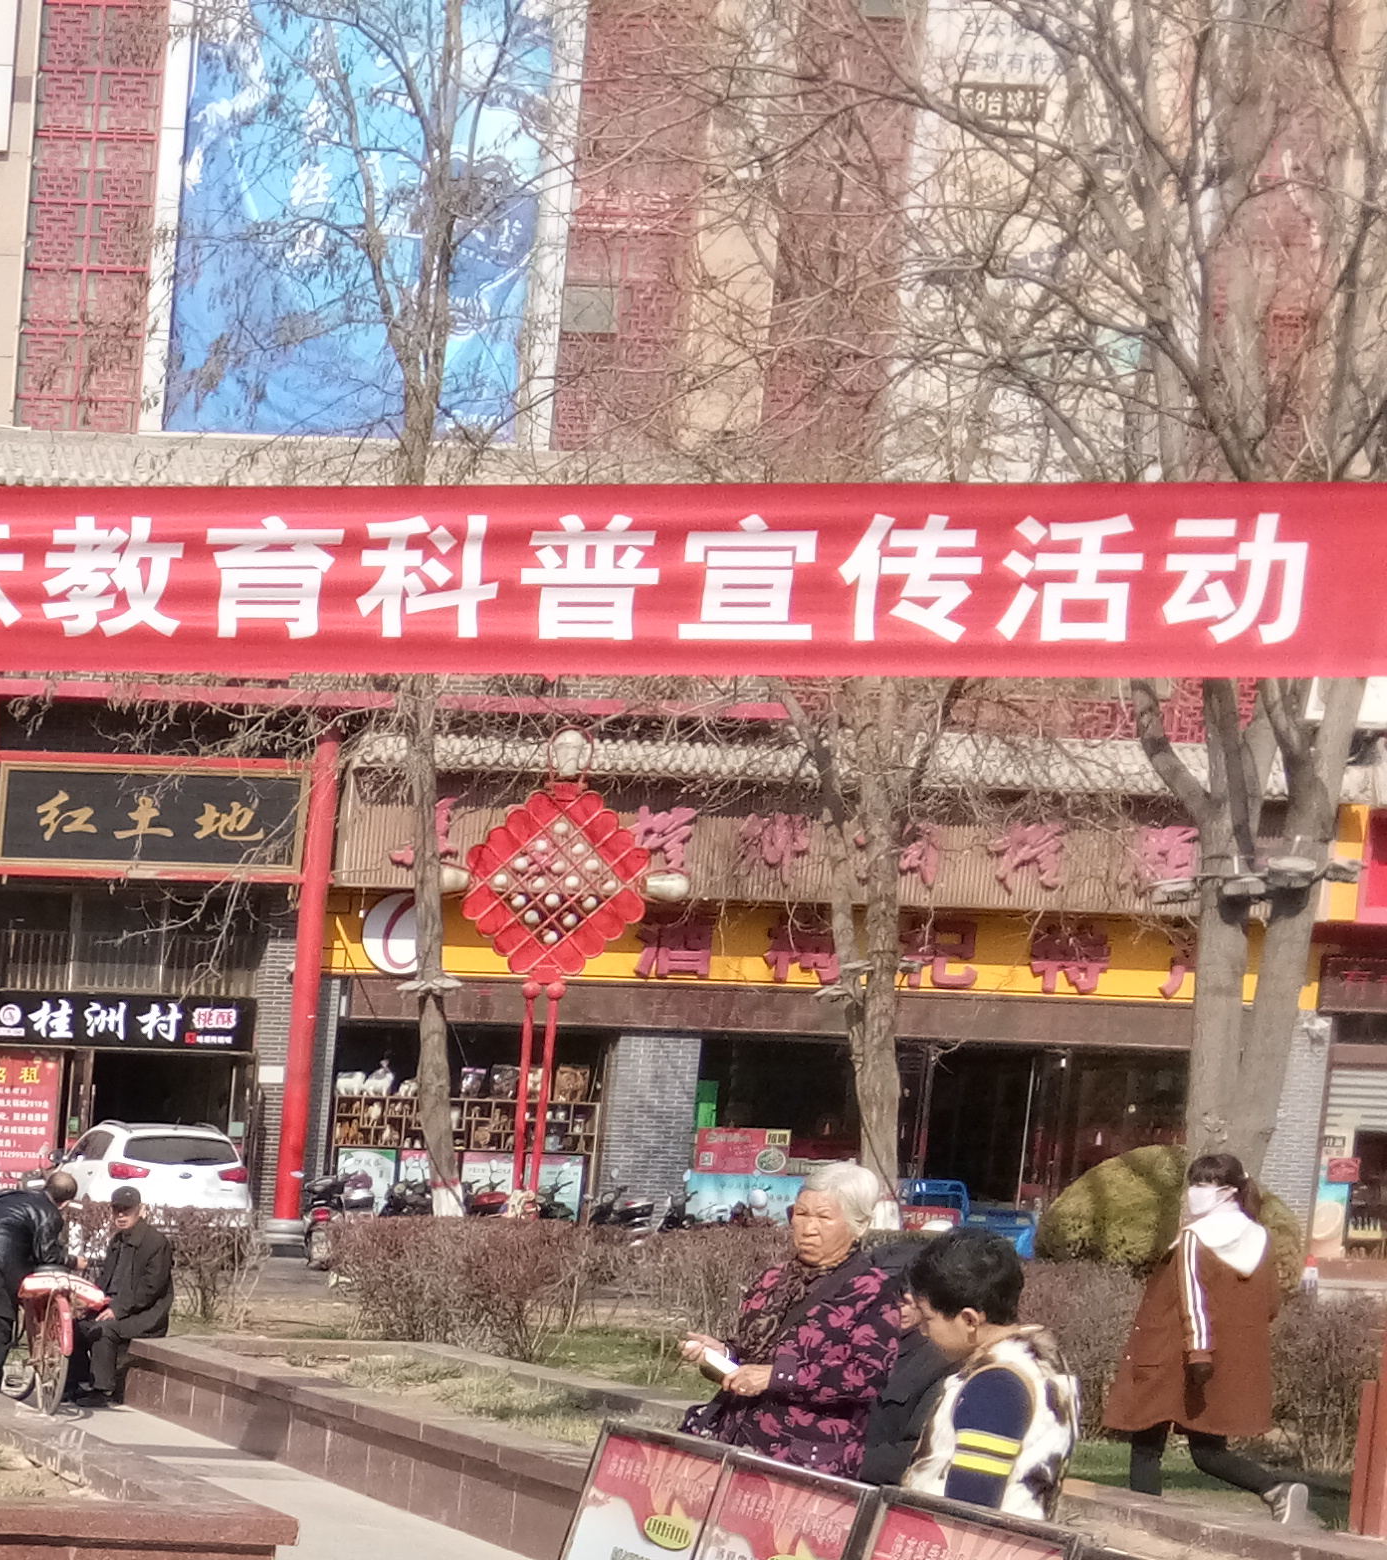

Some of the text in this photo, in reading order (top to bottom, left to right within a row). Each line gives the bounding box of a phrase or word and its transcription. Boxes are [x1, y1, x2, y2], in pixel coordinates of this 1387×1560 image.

[37, 789, 265, 842] 红土地
[28, 998, 183, 1042] 桂洲村
[195, 1008, 235, 1028] 桃酥
